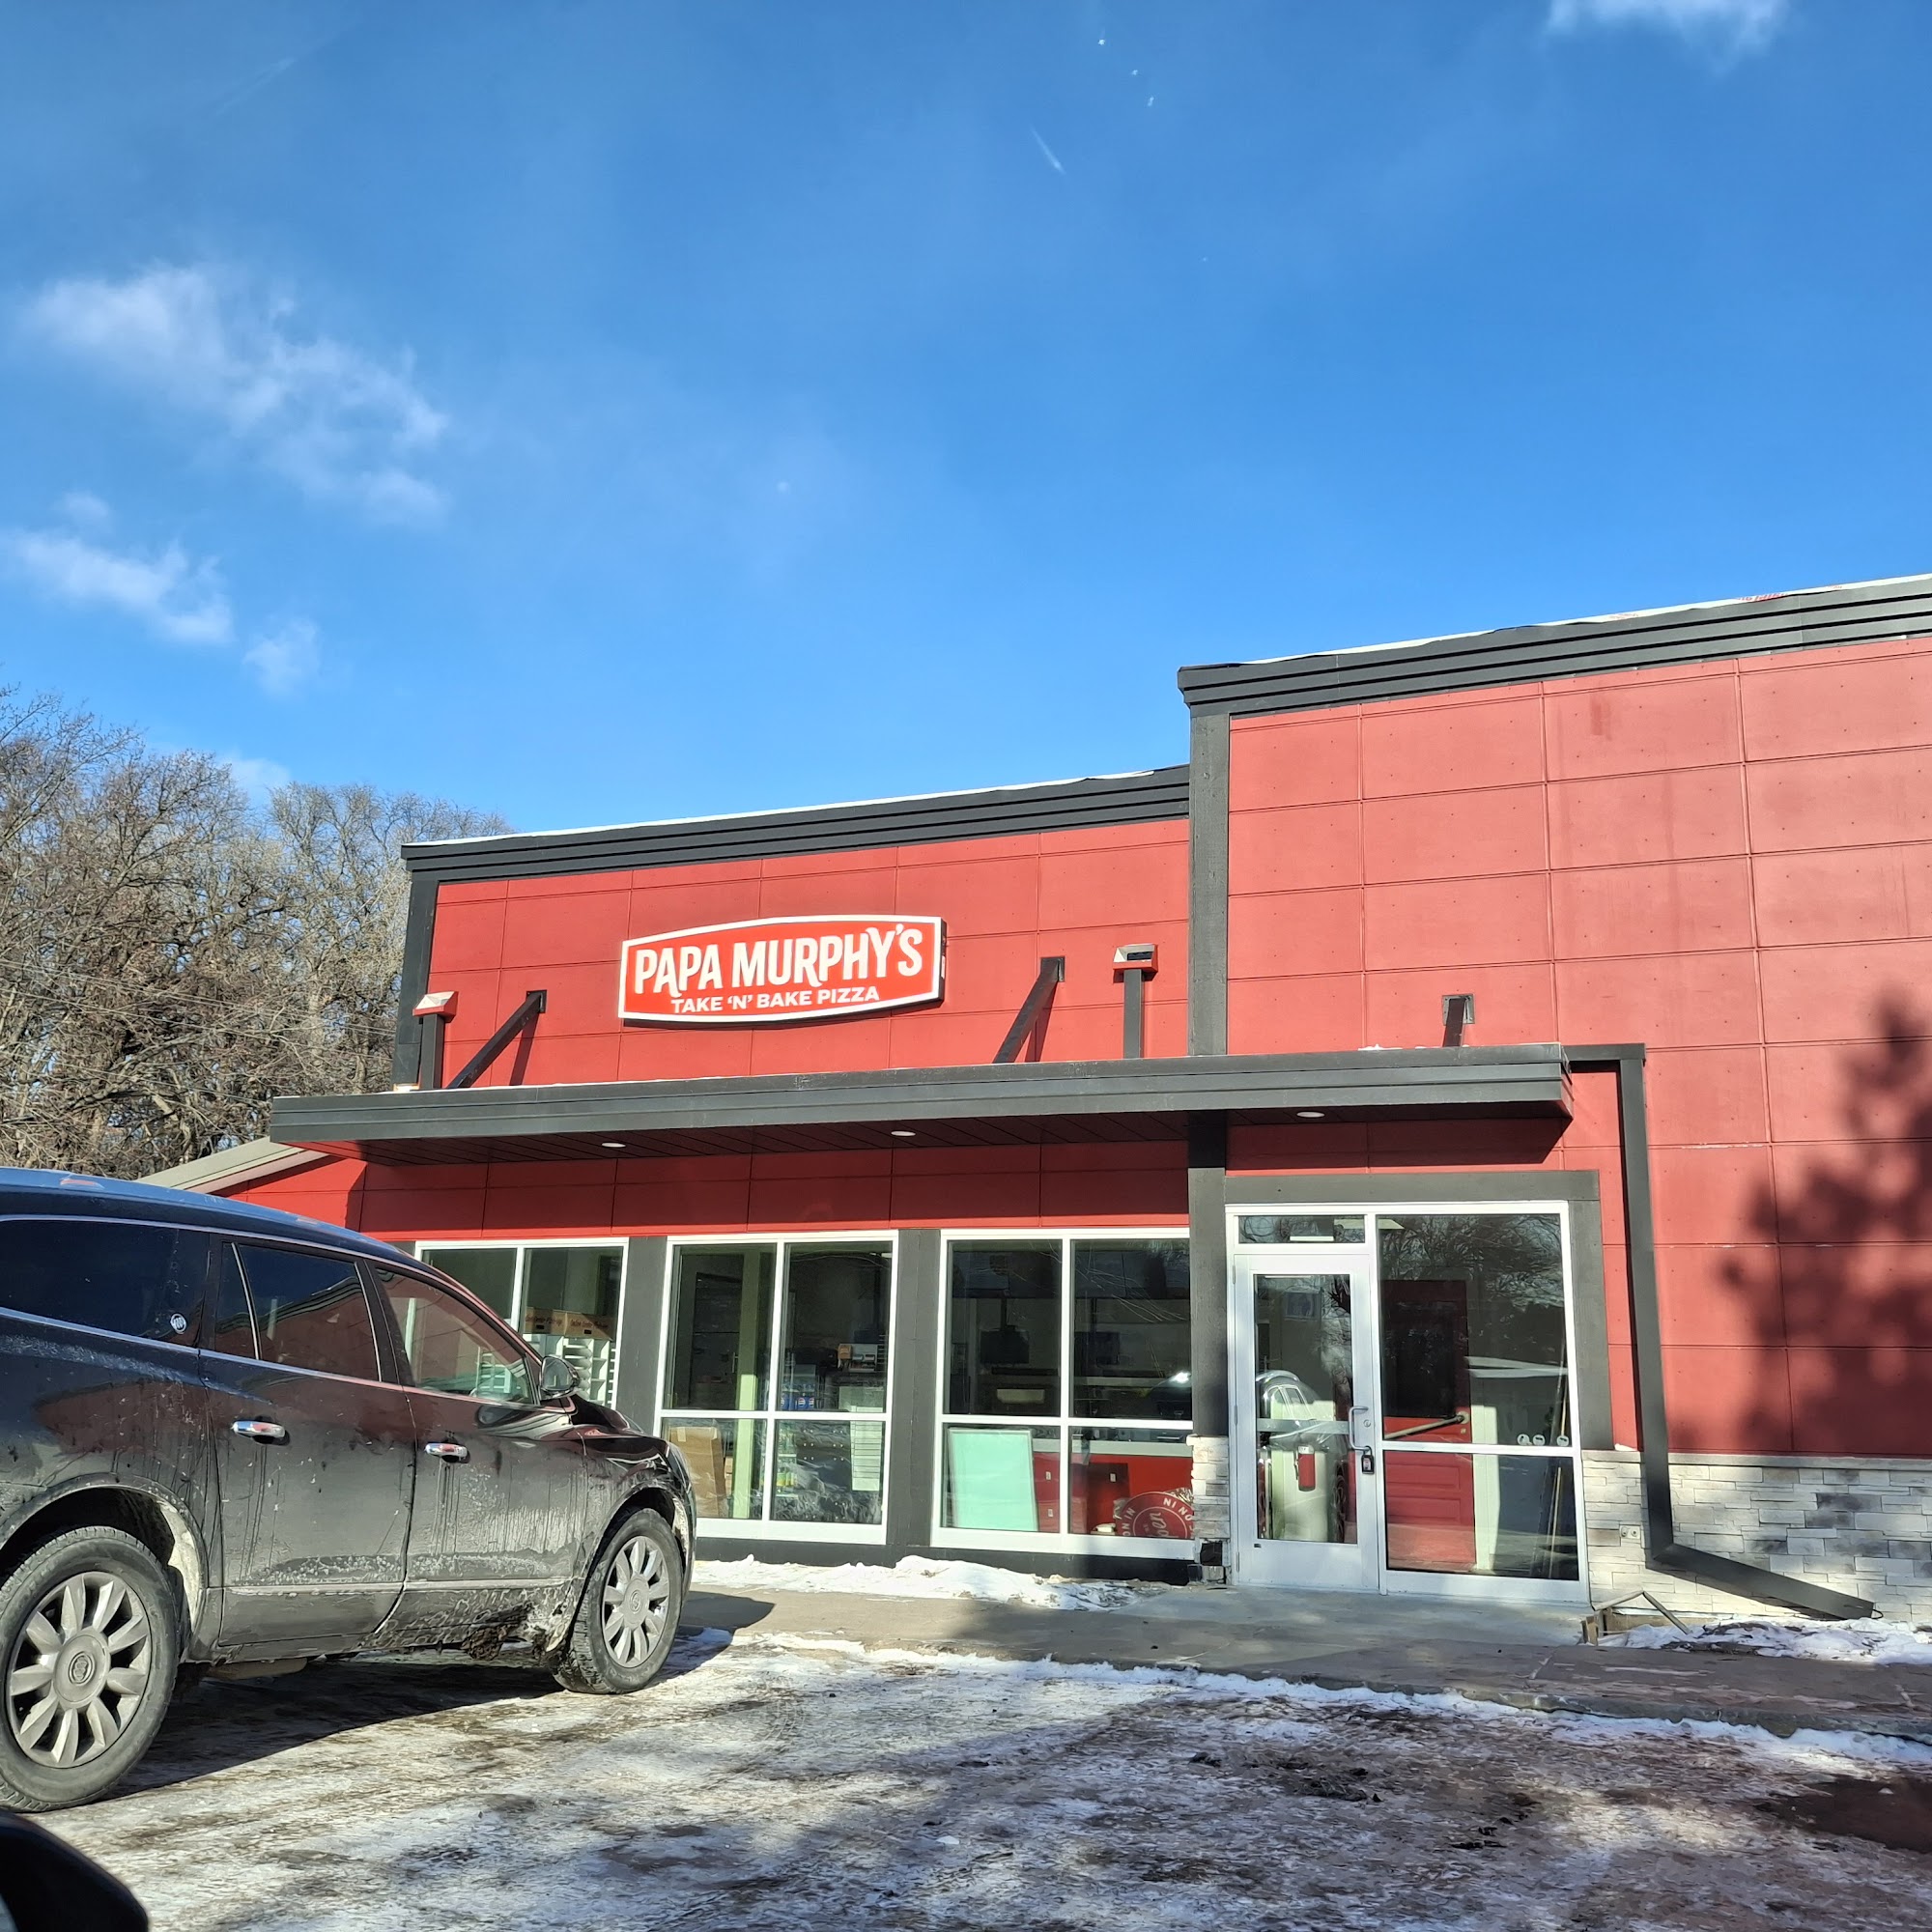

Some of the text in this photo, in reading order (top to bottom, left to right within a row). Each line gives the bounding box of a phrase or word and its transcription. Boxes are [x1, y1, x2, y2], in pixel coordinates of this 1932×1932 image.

[635, 923, 923, 998] PAPA MURPHY'S
[671, 996, 724, 1013] TAKE
[757, 991, 812, 1009] BAKE
[818, 986, 880, 1004] PIZZA
